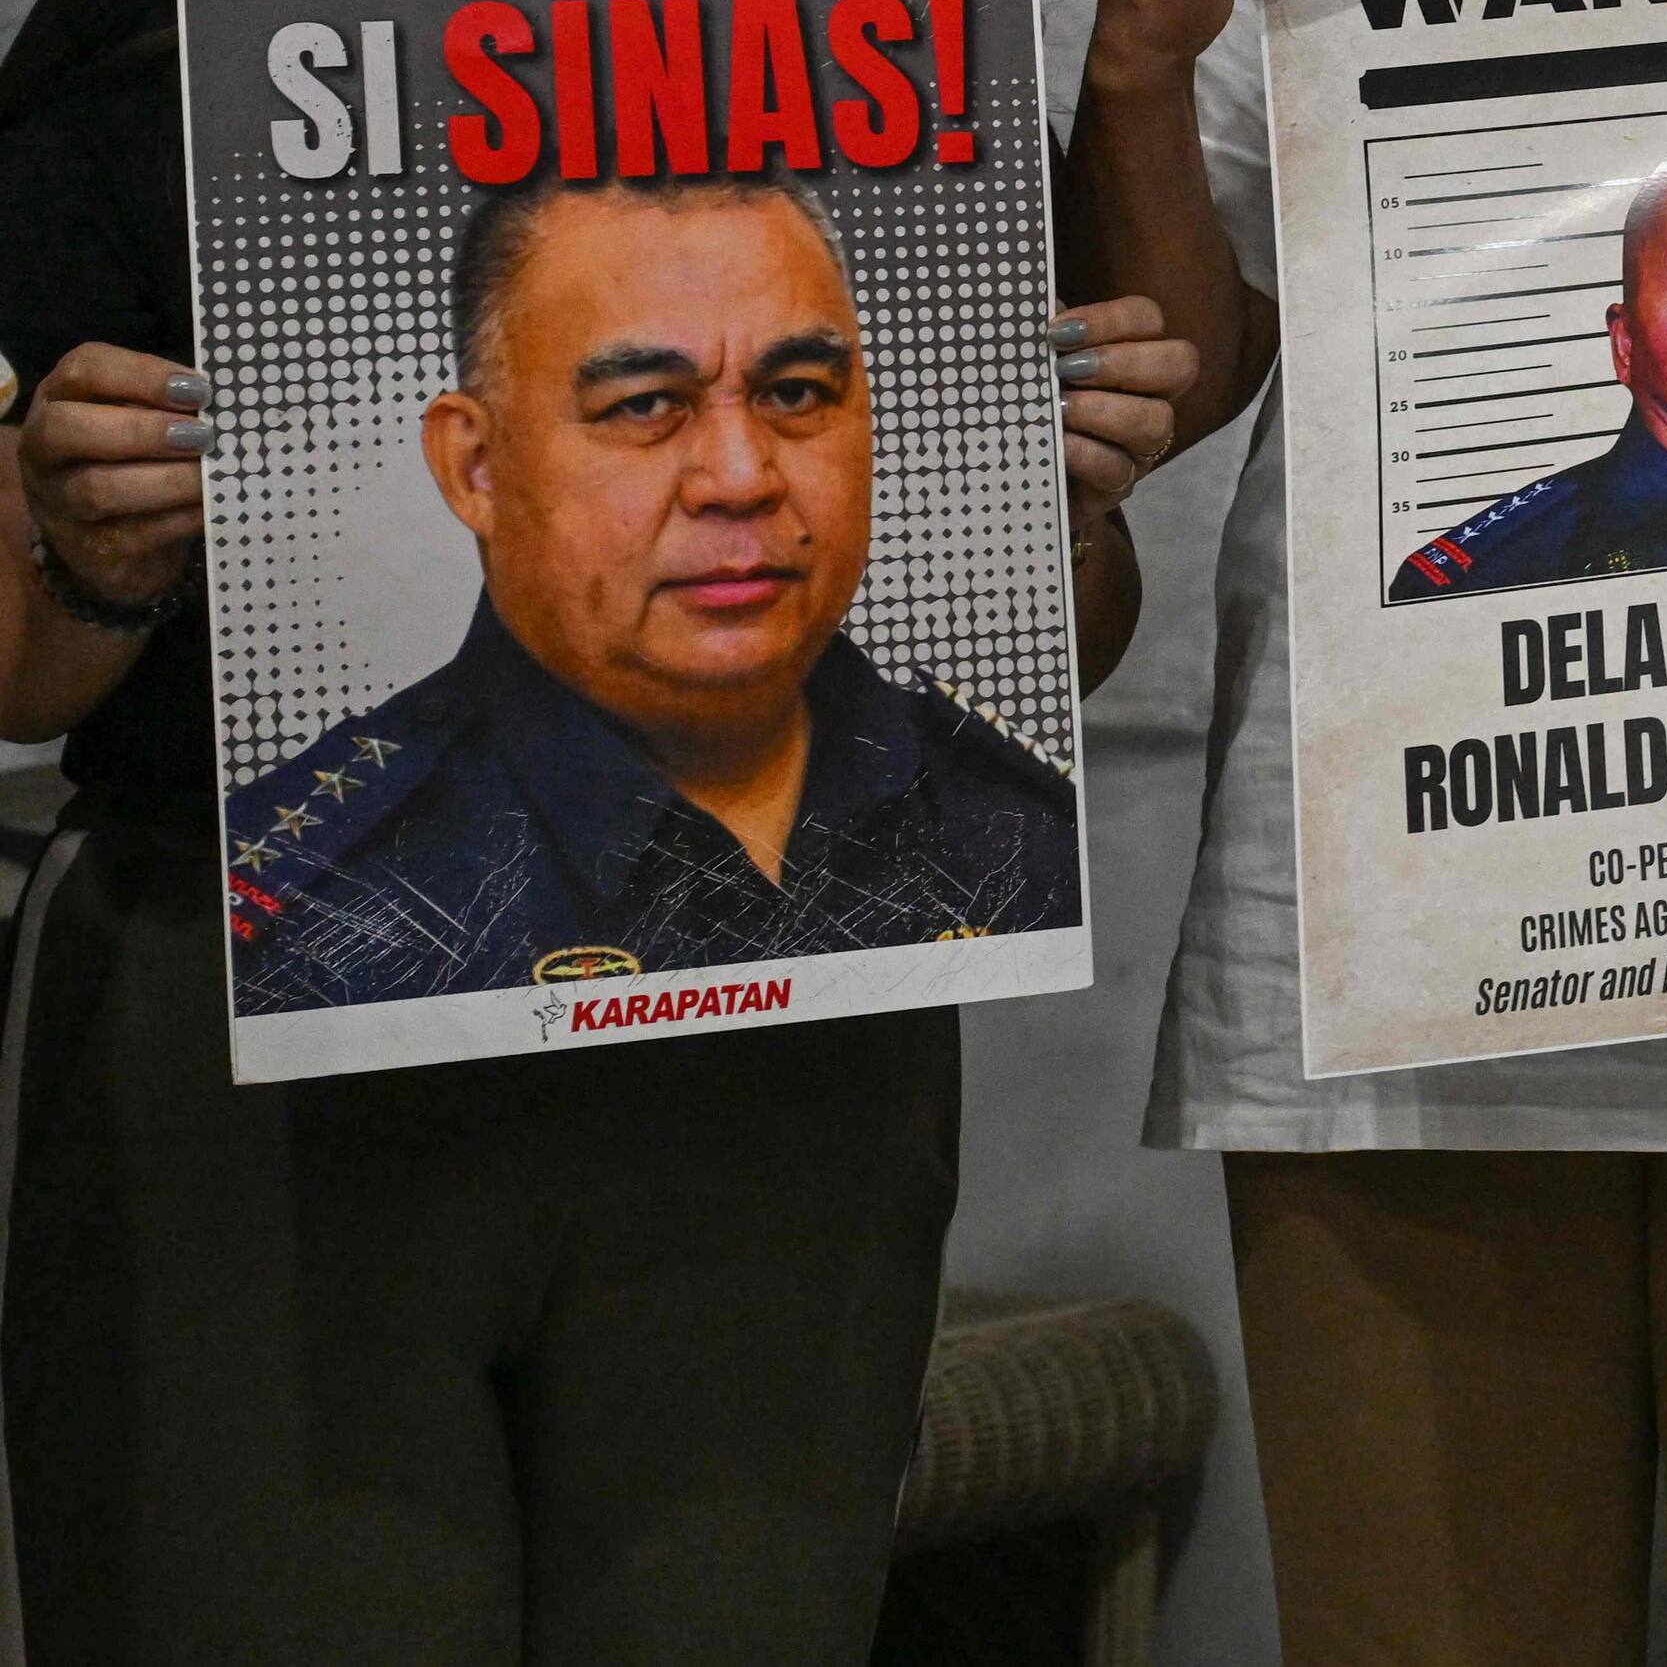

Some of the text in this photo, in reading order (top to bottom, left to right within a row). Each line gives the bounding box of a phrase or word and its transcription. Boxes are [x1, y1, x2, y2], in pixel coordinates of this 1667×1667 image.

[268, 21, 403, 178] SI
[1381, 197, 1400, 209] 05
[1384, 248, 1403, 260] 10
[1388, 350, 1407, 362] 20
[1390, 400, 1408, 412] 25
[1391, 450, 1410, 462] 30
[1392, 500, 1410, 512] 35
[1501, 603, 1667, 706] DELA
[1521, 905, 1626, 952] CRIMES
[1476, 970, 1594, 1015] Senator
[1600, 958, 1656, 1001] and
[573, 980, 791, 1031] KARAPATAN
